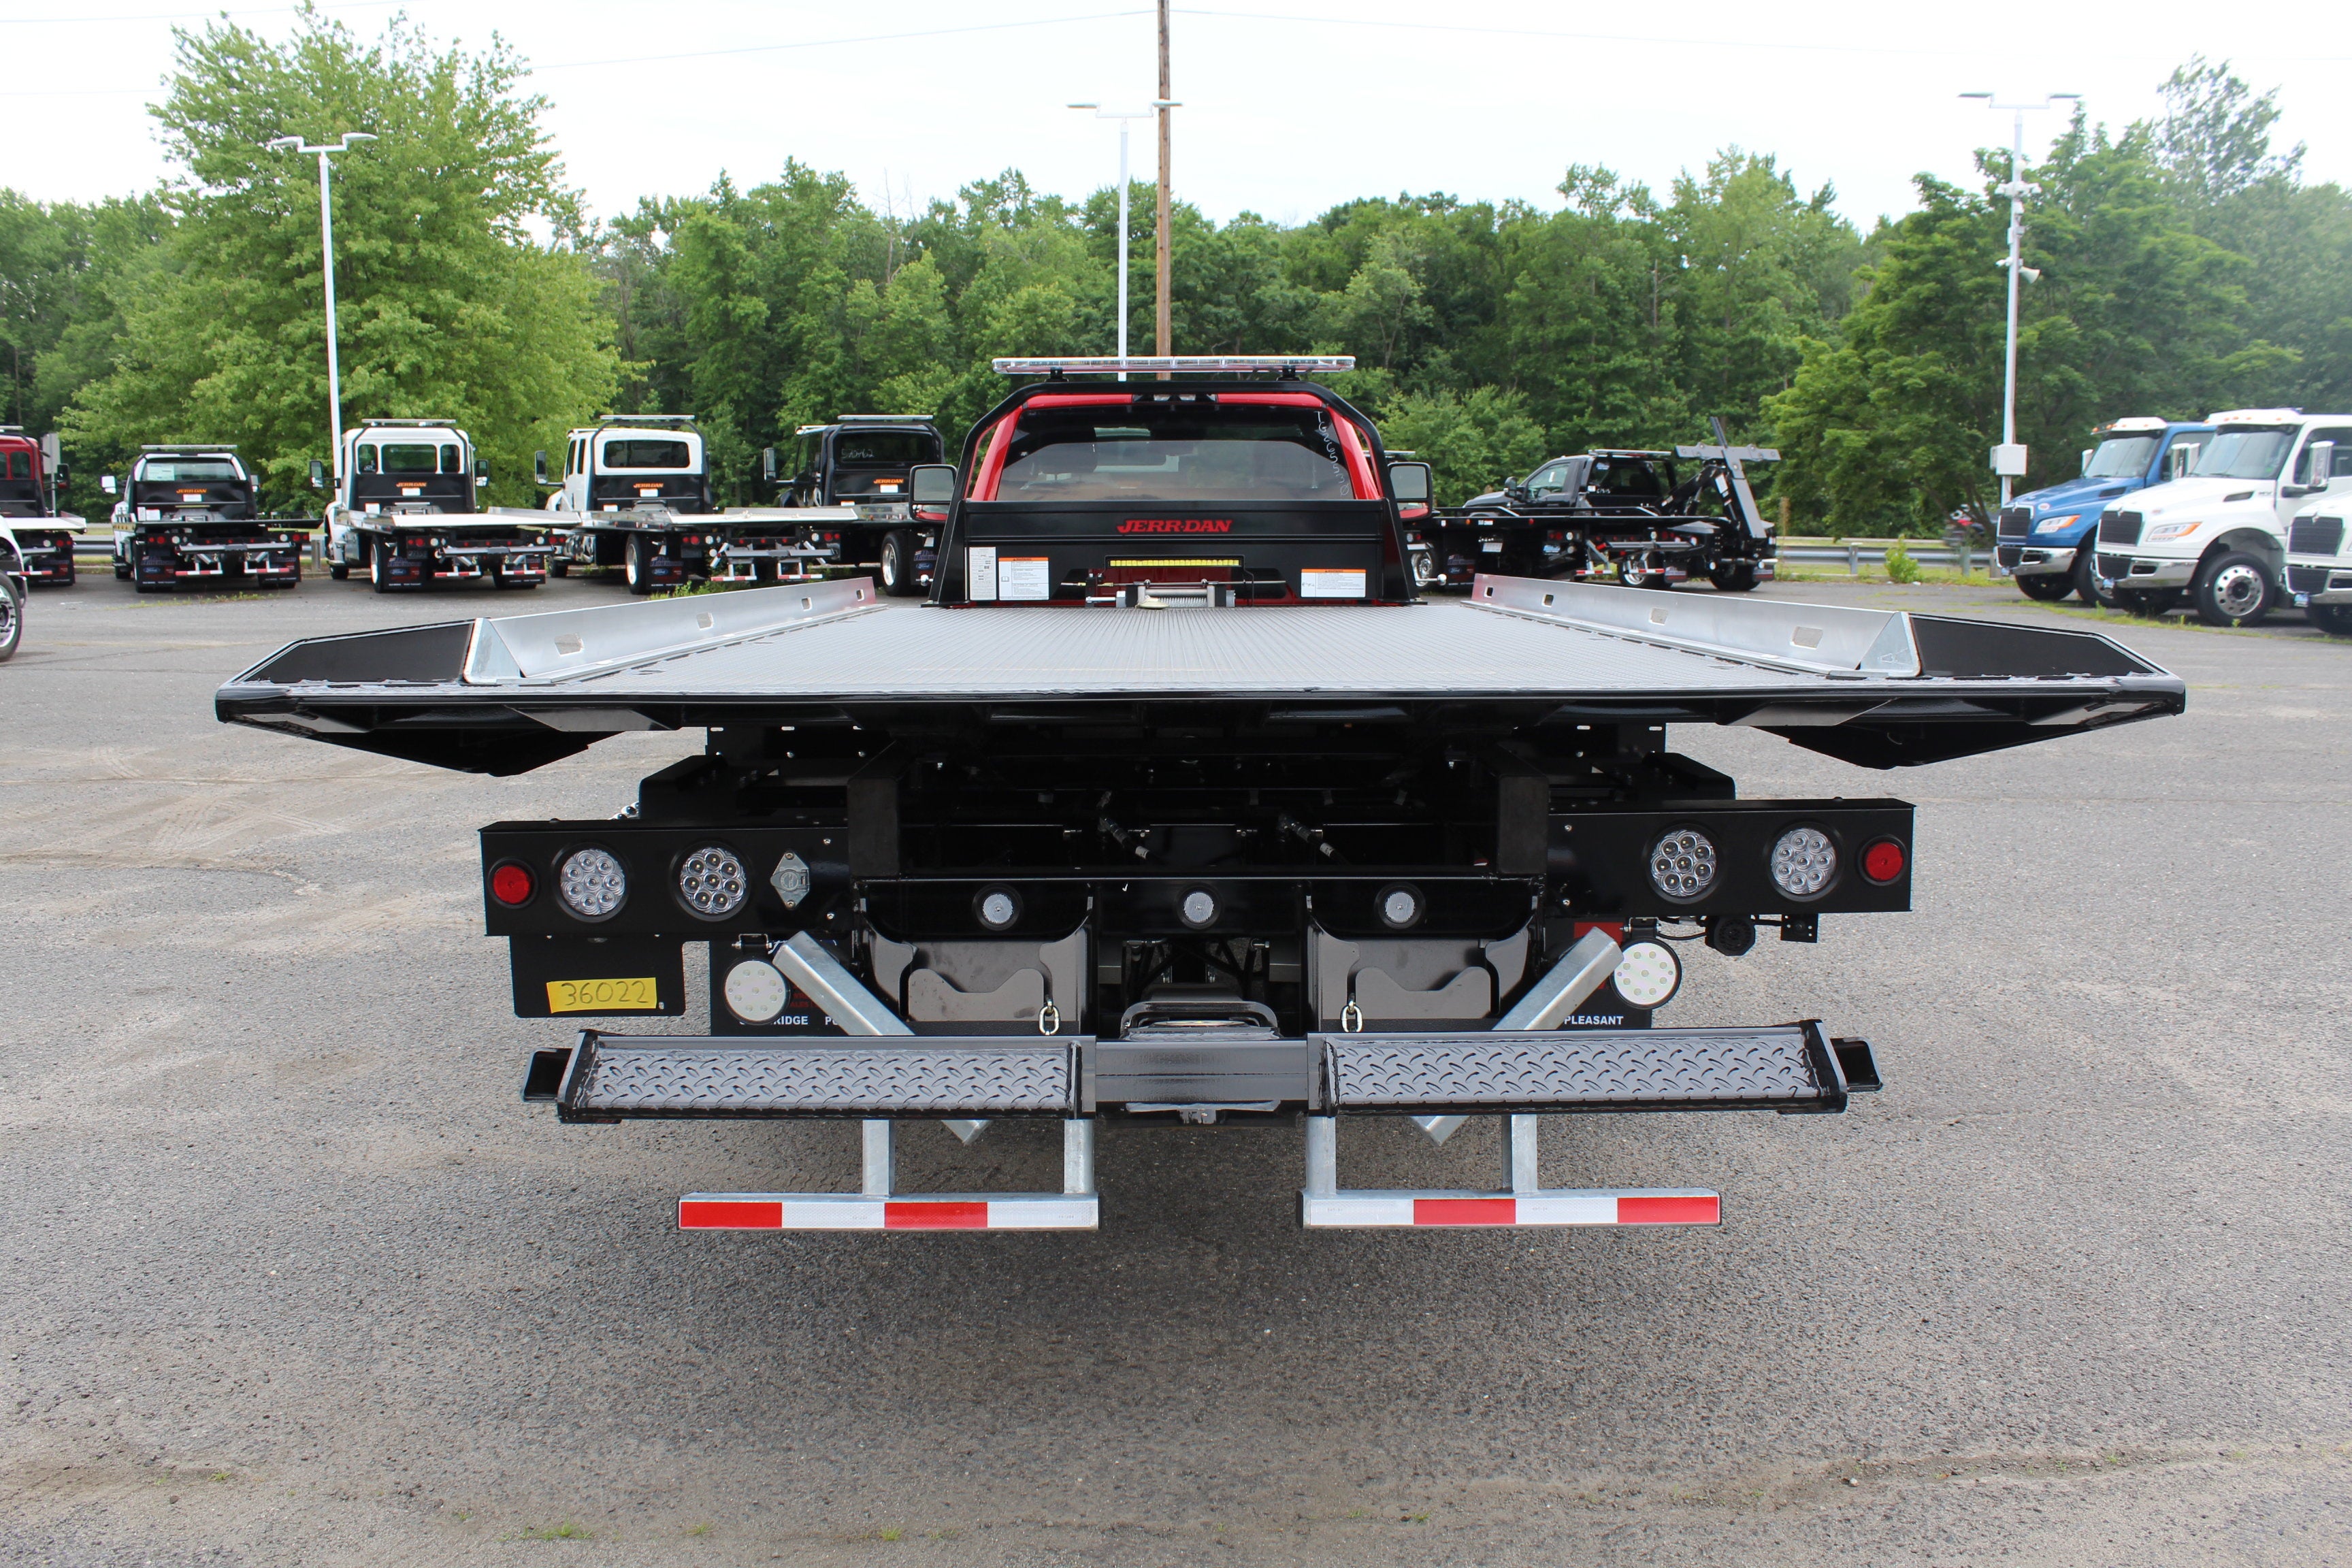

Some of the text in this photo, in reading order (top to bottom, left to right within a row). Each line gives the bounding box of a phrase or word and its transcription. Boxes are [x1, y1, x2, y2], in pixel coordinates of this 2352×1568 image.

[1116, 519, 1232, 533] JERR-DAN
[561, 981, 648, 1006] 36022
[1564, 1016, 1624, 1025] PLEASANT
